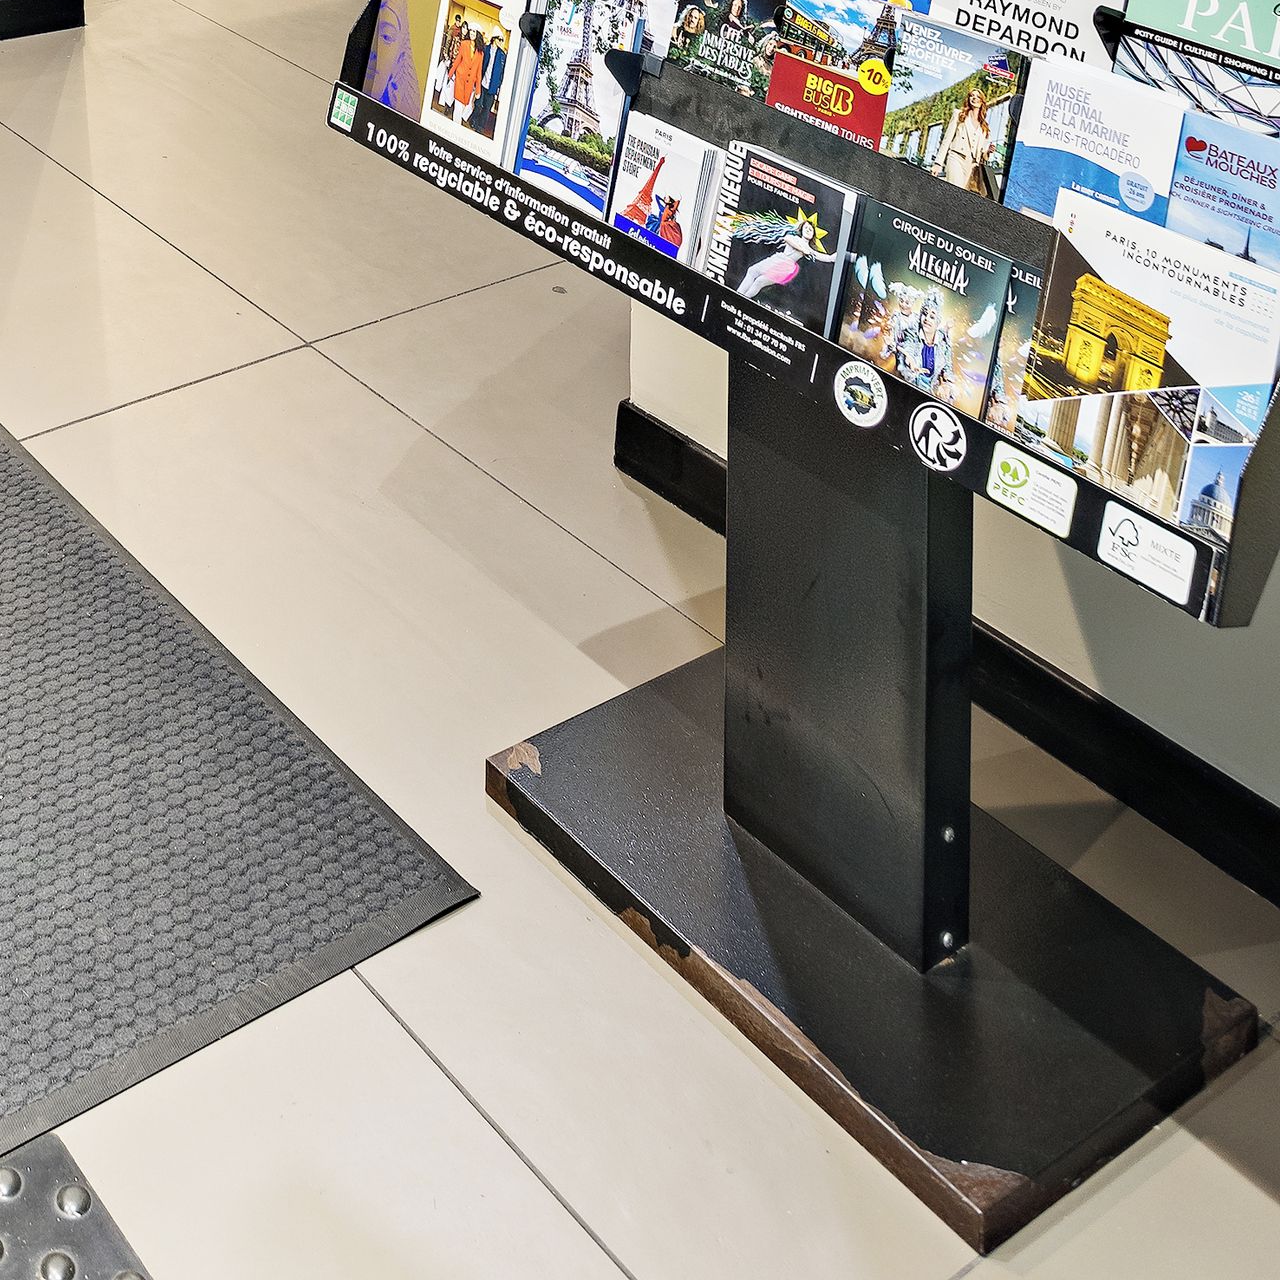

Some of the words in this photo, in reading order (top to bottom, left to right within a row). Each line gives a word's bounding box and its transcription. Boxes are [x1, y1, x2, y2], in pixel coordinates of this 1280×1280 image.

[955, 7, 1086, 63] DEPARDON
[1134, 28, 1155, 40] #CITY
[1154, 34, 1178, 49] GUIDE
[1184, 43, 1218, 61] CULTURE
[1223, 56, 1268, 77] SHOPPING
[806, 72, 834, 94] BIG
[860, 69, 890, 90] -10%
[1046, 79, 1093, 106] MUSÉE
[803, 89, 831, 110] BUS
[1044, 92, 1104, 125] NATIONAL
[654, 128, 673, 142] PARIS
[774, 101, 841, 138] SIGHTSEEING
[840, 124, 875, 151] TOURS
[1042, 106, 1058, 121] DE
[1060, 113, 1077, 129] LA
[1078, 119, 1131, 149] MARINE
[625, 147, 658, 173] DEPARTMENT
[627, 133, 637, 148] THE
[636, 138, 660, 160] PARISIAN
[1039, 122, 1141, 170] PARIS-TROCADÉRO
[1207, 142, 1279, 180] BATEAUX
[622, 160, 640, 179] STORE
[1204, 156, 1278, 191] MOUCHES
[427, 138, 454, 166] Votre
[454, 152, 493, 187] service
[571, 218, 612, 251] gratuit
[747, 175, 763, 188] POUR
[763, 183, 774, 193] LES
[773, 188, 800, 205] FAMILLES
[1173, 180, 1218, 204] CROISIÈRE
[1218, 196, 1275, 224] PROMENADE
[365, 120, 412, 163] 100%
[412, 148, 502, 214] recyclable
[502, 197, 521, 222] &
[523, 209, 687, 317] éco-responsable
[891, 216, 936, 248] CIRQUE
[936, 236, 954, 253] DU
[953, 243, 996, 274] SOLEIL
[1105, 230, 1140, 252] PARIS,
[1145, 249, 1158, 261] 10
[1161, 254, 1249, 298] MONUMENTS
[1121, 250, 1247, 308] INCONTOURNABLES
[992, 484, 1027, 507] PEFC
[1110, 541, 1137, 563] FSC
[1149, 538, 1182, 564] MIXTE
